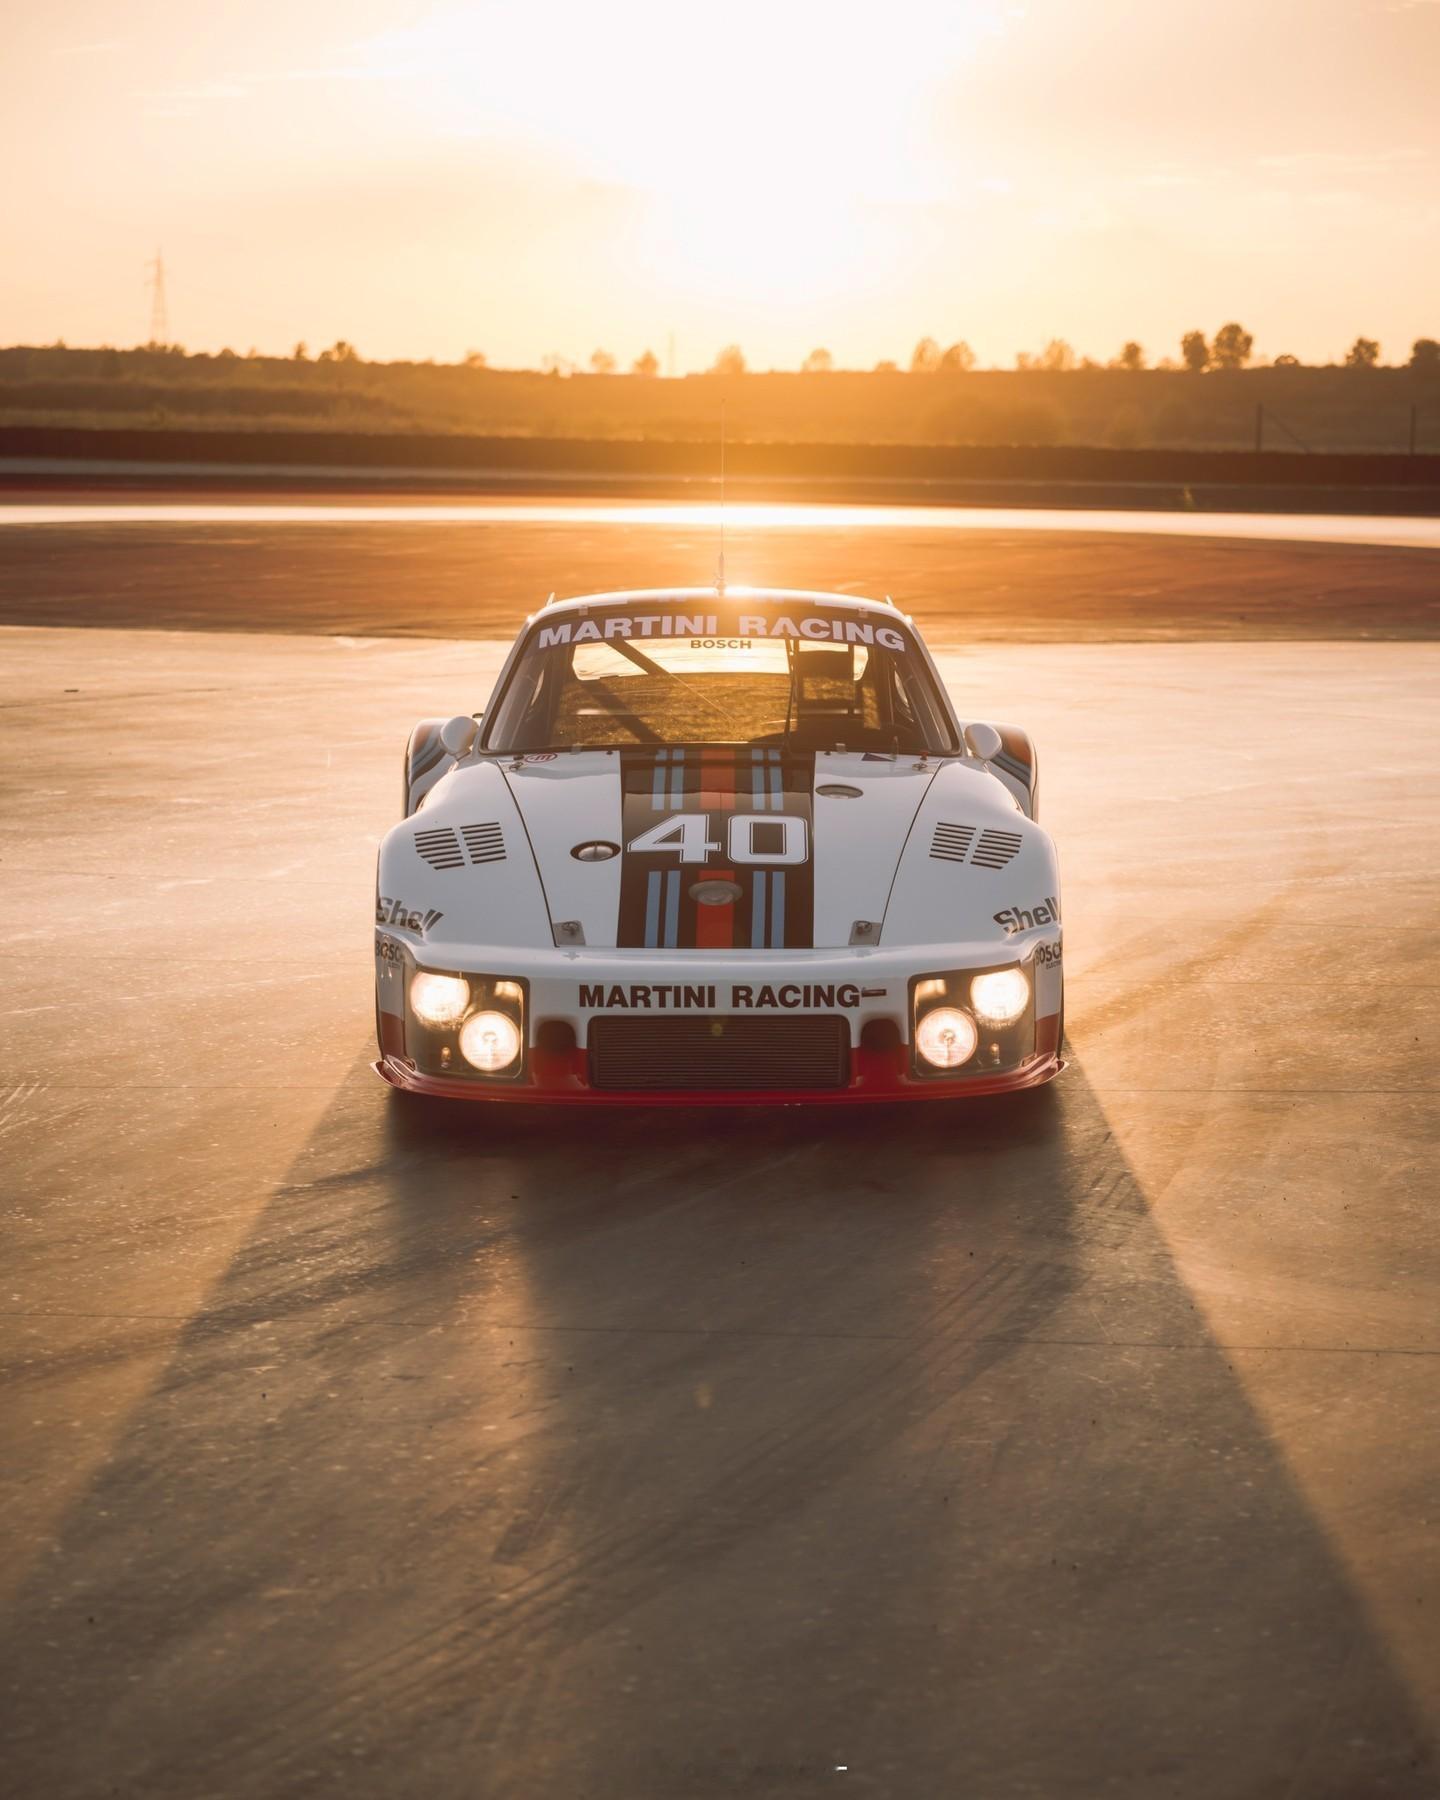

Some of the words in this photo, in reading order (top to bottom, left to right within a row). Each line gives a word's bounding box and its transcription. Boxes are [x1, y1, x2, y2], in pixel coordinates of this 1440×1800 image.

[539, 615, 717, 648] MARTINI
[738, 616, 905, 651] RACING
[691, 639, 752, 650] BOSCH
[627, 814, 809, 865] 40
[376, 940, 404, 961] BOSC
[579, 984, 716, 1008] MARTINI
[732, 984, 860, 1008] RACING
